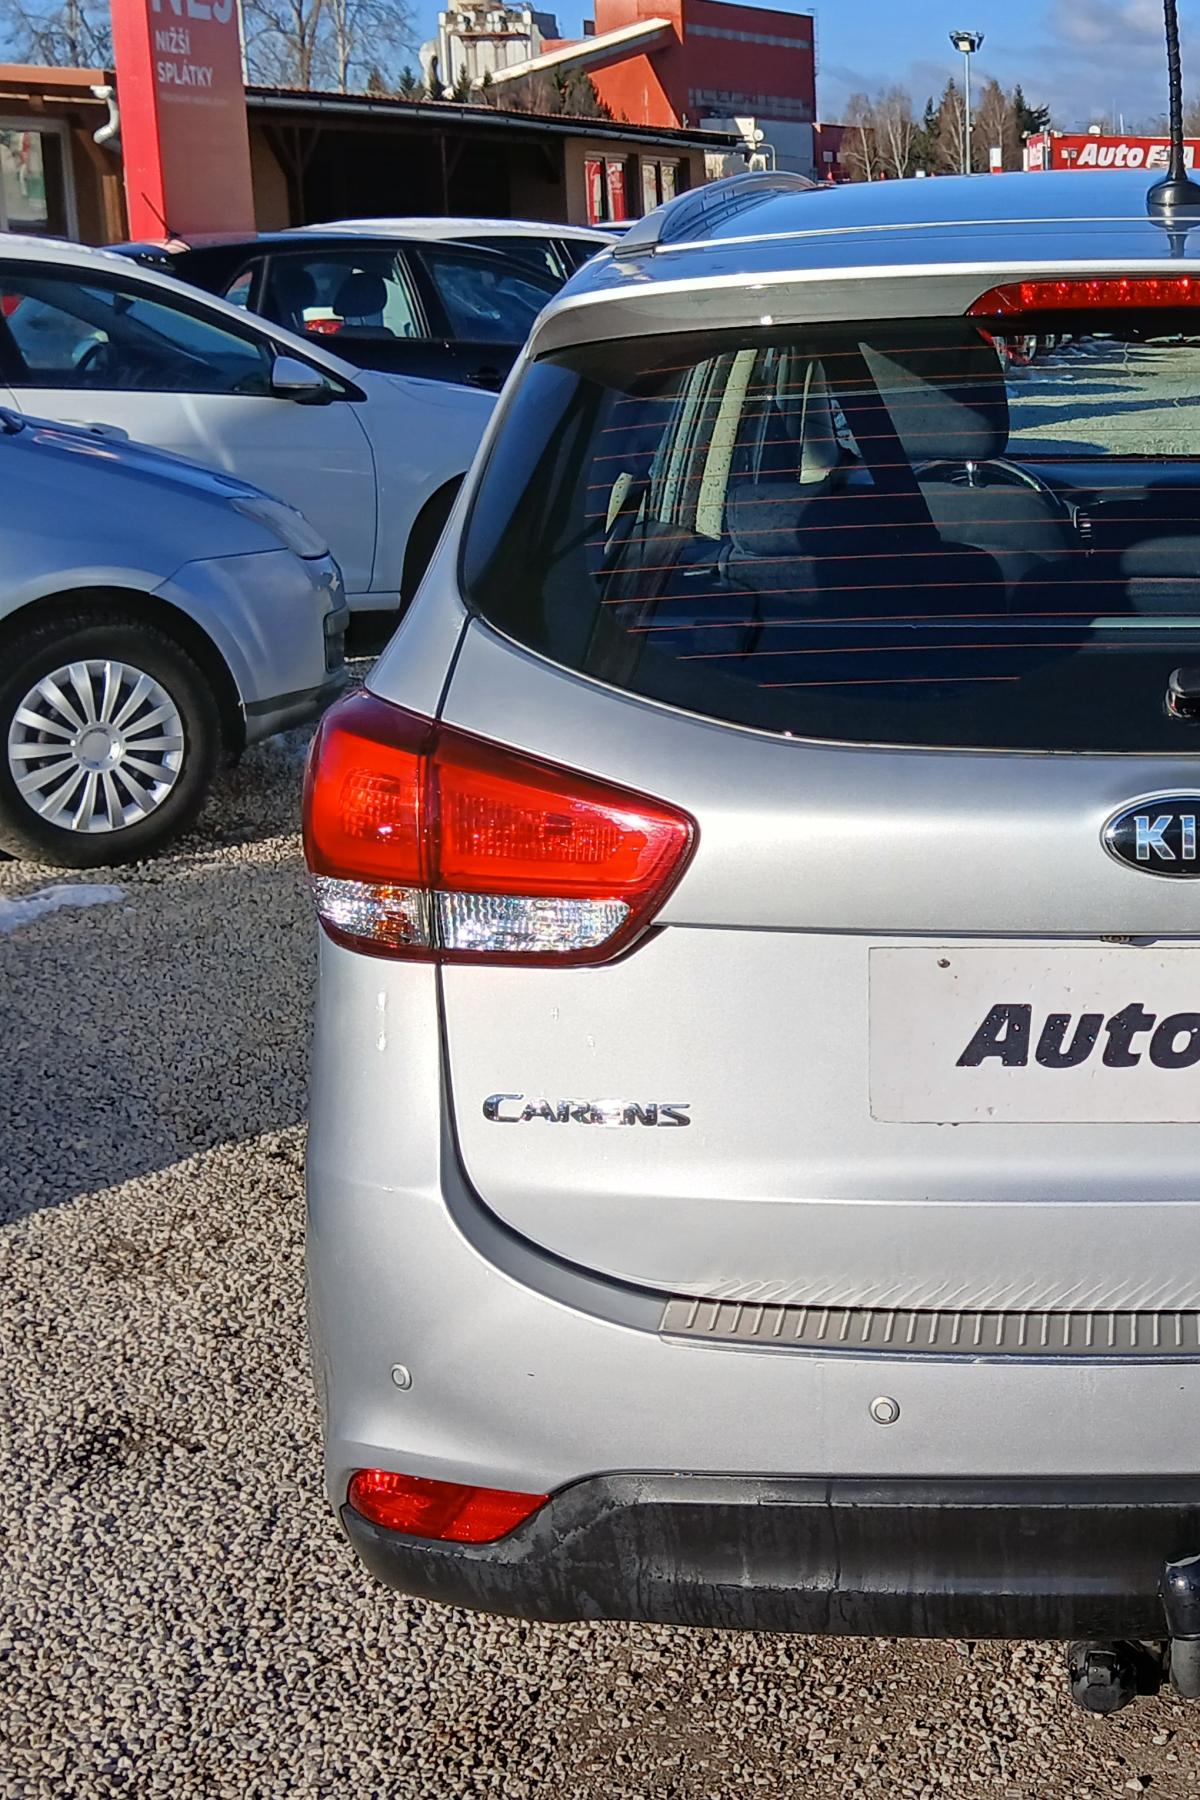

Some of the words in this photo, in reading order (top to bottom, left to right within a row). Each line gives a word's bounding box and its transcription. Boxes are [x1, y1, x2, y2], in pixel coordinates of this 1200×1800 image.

[155, 26, 191, 55] NIŽŠÍ
[156, 59, 213, 87] SPLÁTKY
[1077, 143, 1144, 168] Auto
[1146, 145, 1195, 168] EA
[482, 1092, 692, 1127] CARENS
